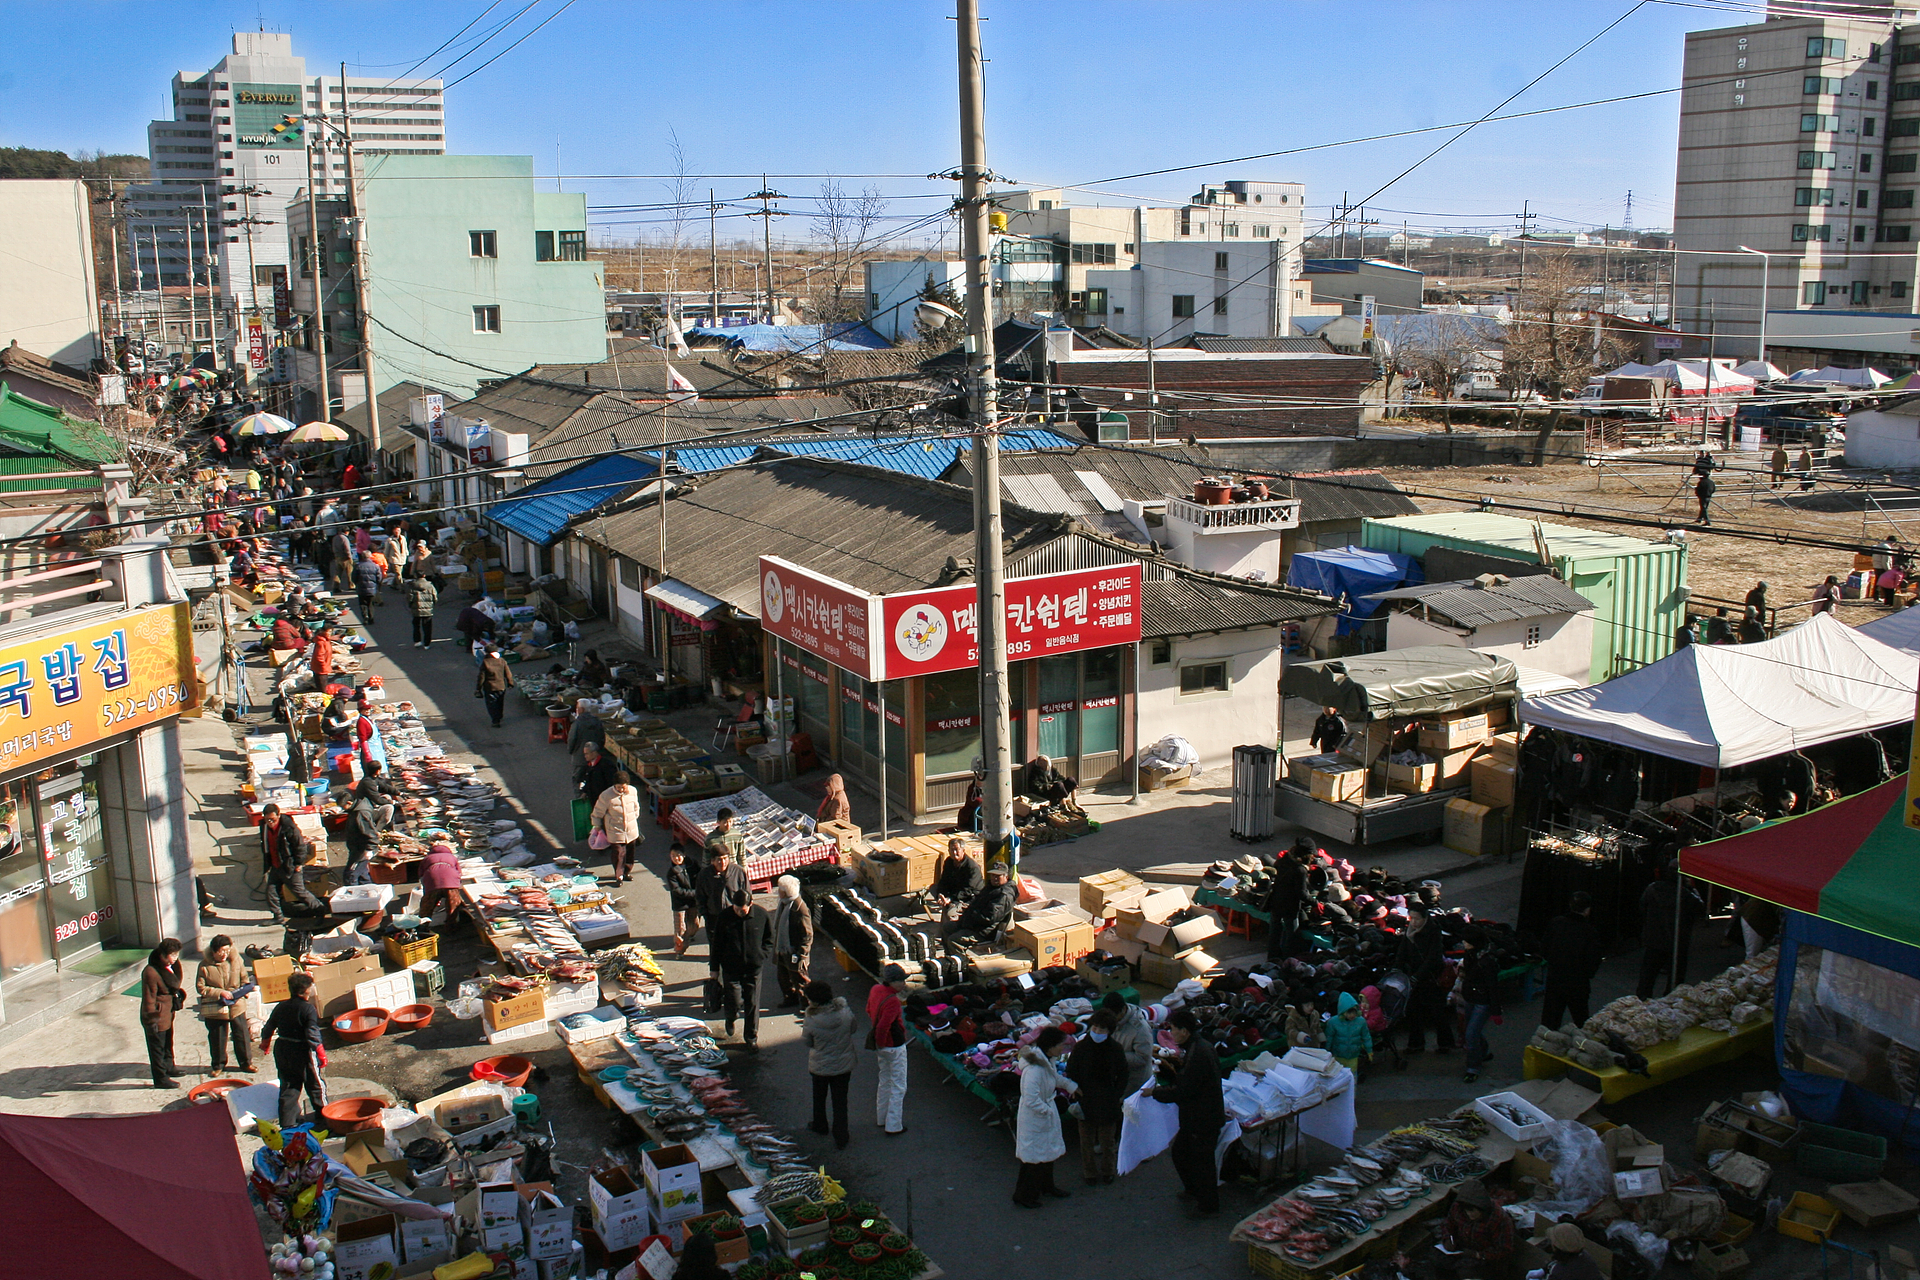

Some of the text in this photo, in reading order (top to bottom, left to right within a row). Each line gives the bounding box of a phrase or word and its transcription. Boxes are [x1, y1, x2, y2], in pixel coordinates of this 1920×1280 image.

[242, 132, 277, 145] HYUNJIN
[264, 154, 281, 165] 101
[250, 327, 264, 368] 시골장터
[1098, 576, 1132, 593] 후라이드
[1098, 593, 1132, 611] 양념치킨
[1098, 612, 1133, 629] 주문배달
[791, 626, 818, 648] 522-3895
[1045, 633, 1080, 648] 일반음식점
[103, 681, 189, 727] 522-0950
[0, 720, 73, 760] 머리국밥
[51, 791, 87, 822] 고향
[64, 818, 88, 901] 국밥집
[55, 905, 114, 943] 522 0950
